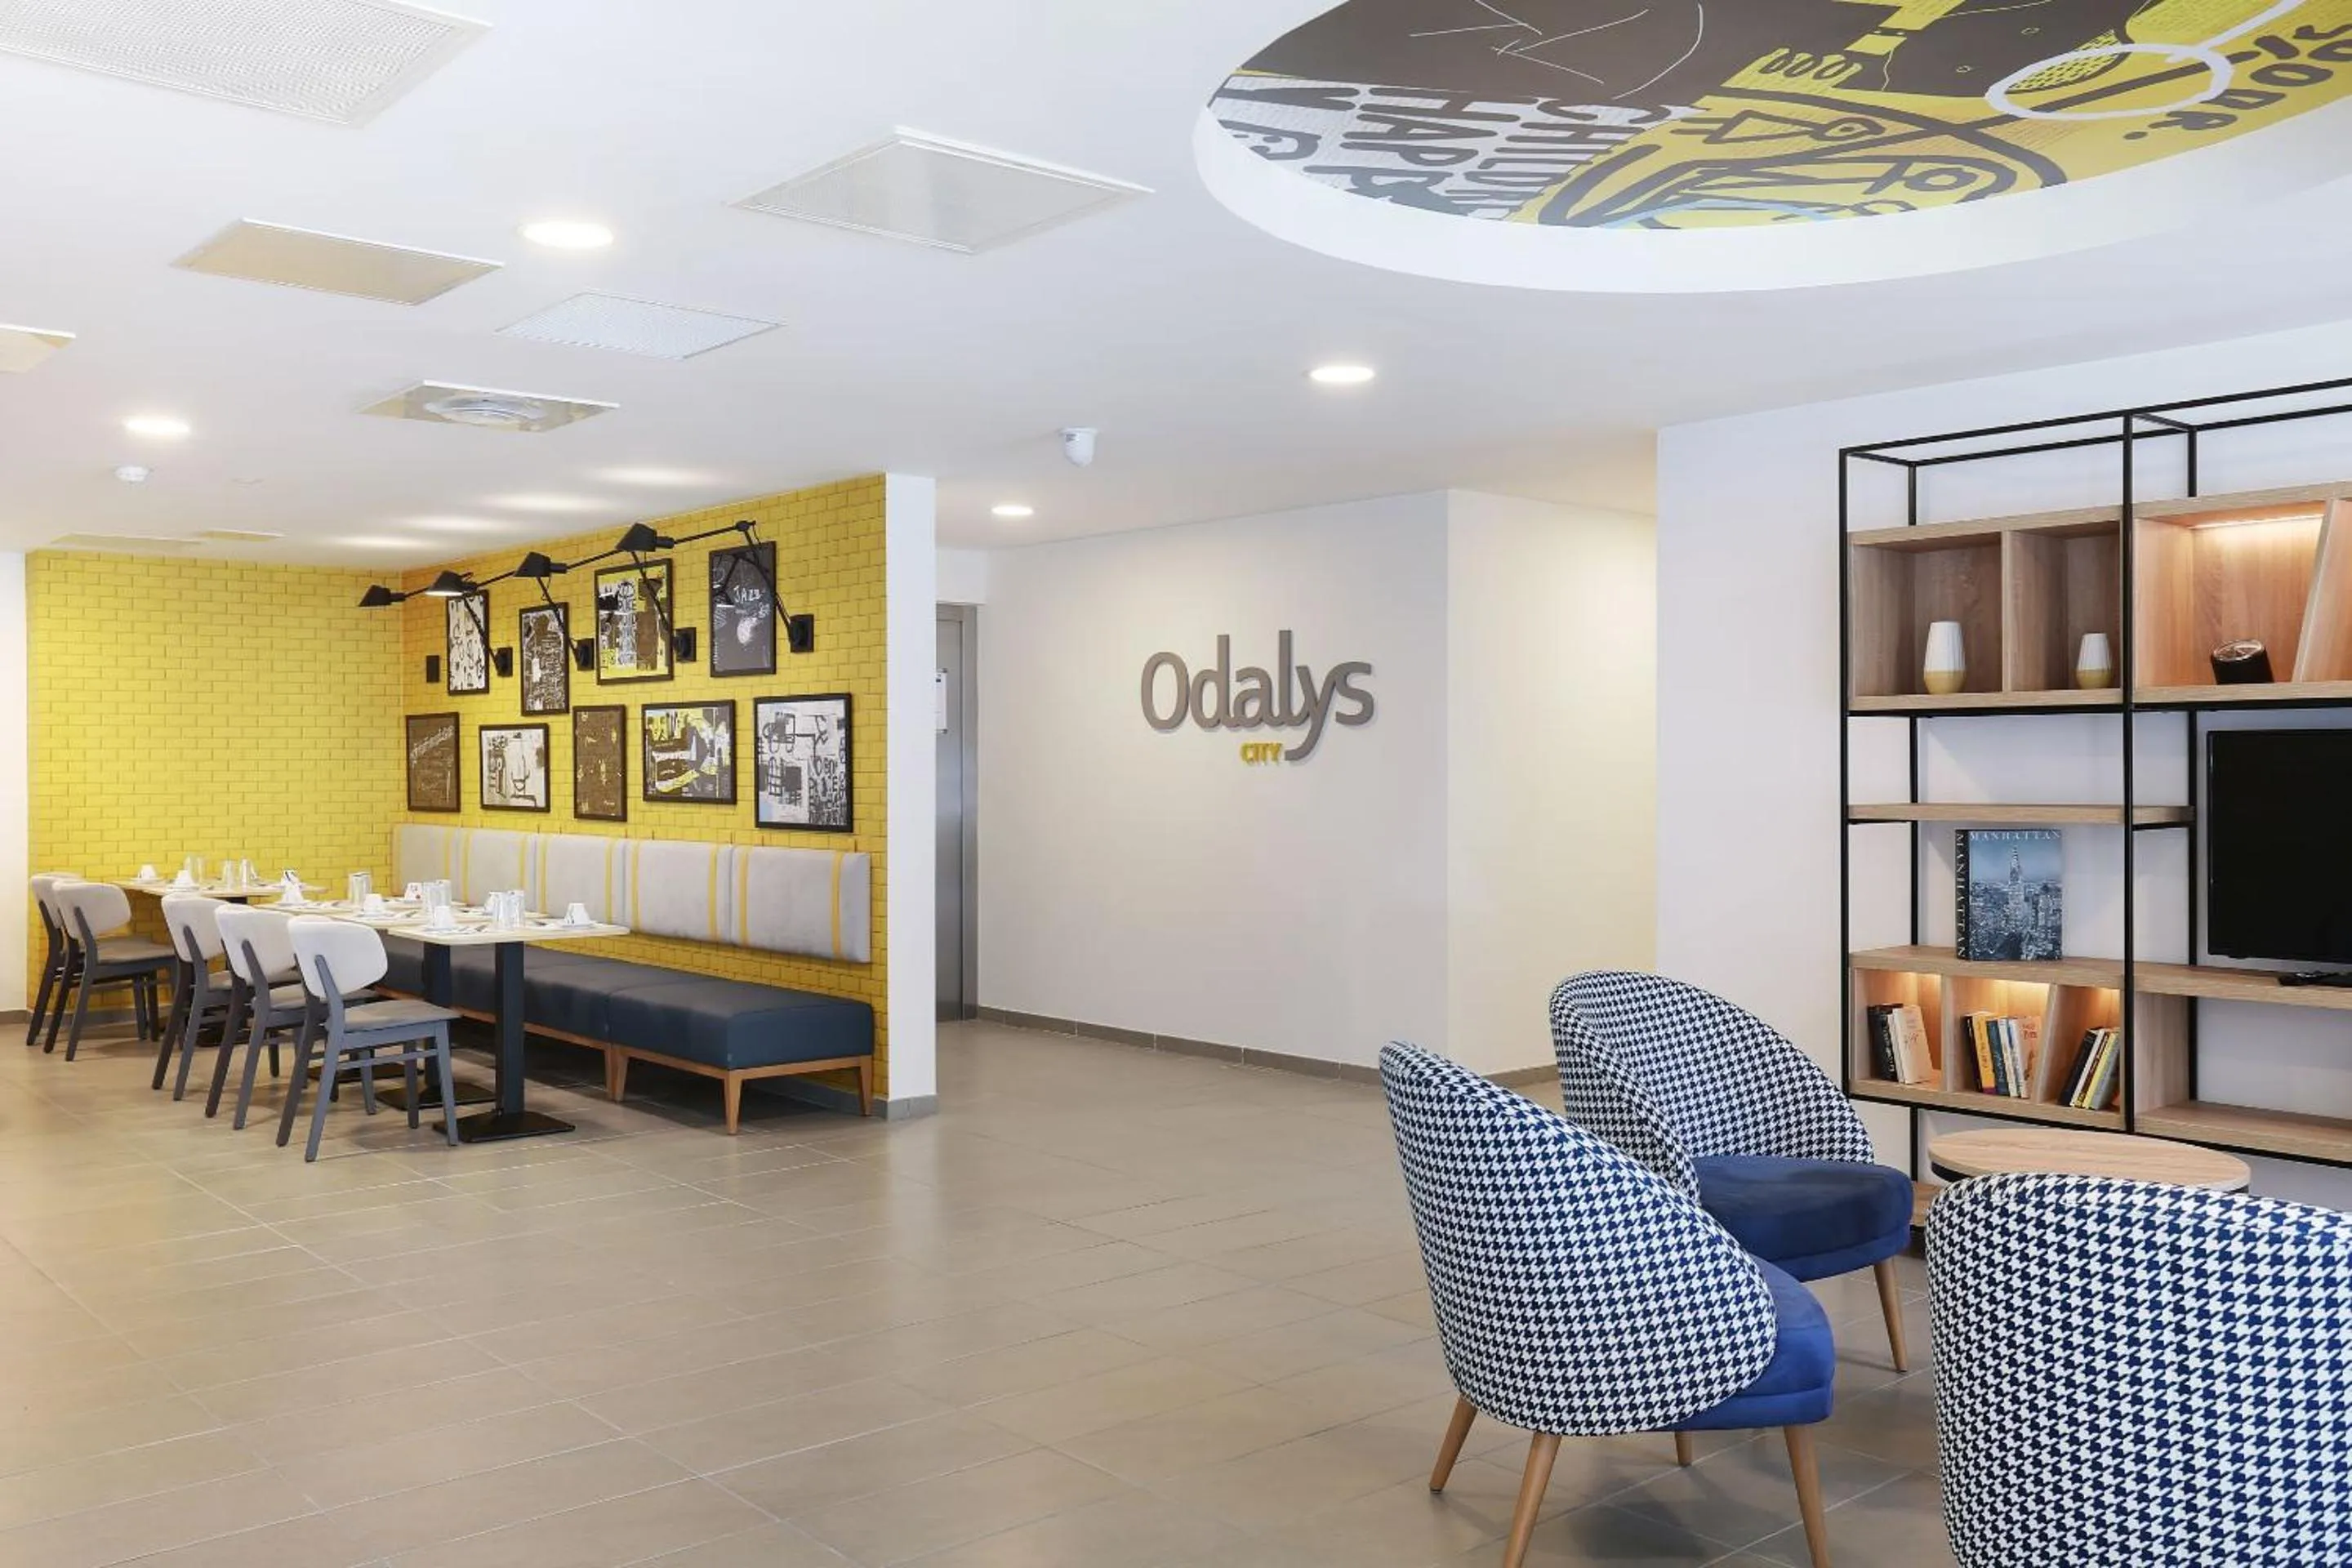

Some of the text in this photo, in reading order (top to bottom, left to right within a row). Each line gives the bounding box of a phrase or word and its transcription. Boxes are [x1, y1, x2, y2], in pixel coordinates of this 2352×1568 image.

[1141, 630, 1374, 761] Odalys
[1241, 742, 1283, 764] CITY
[1970, 831, 2061, 841] MANHATTAN
